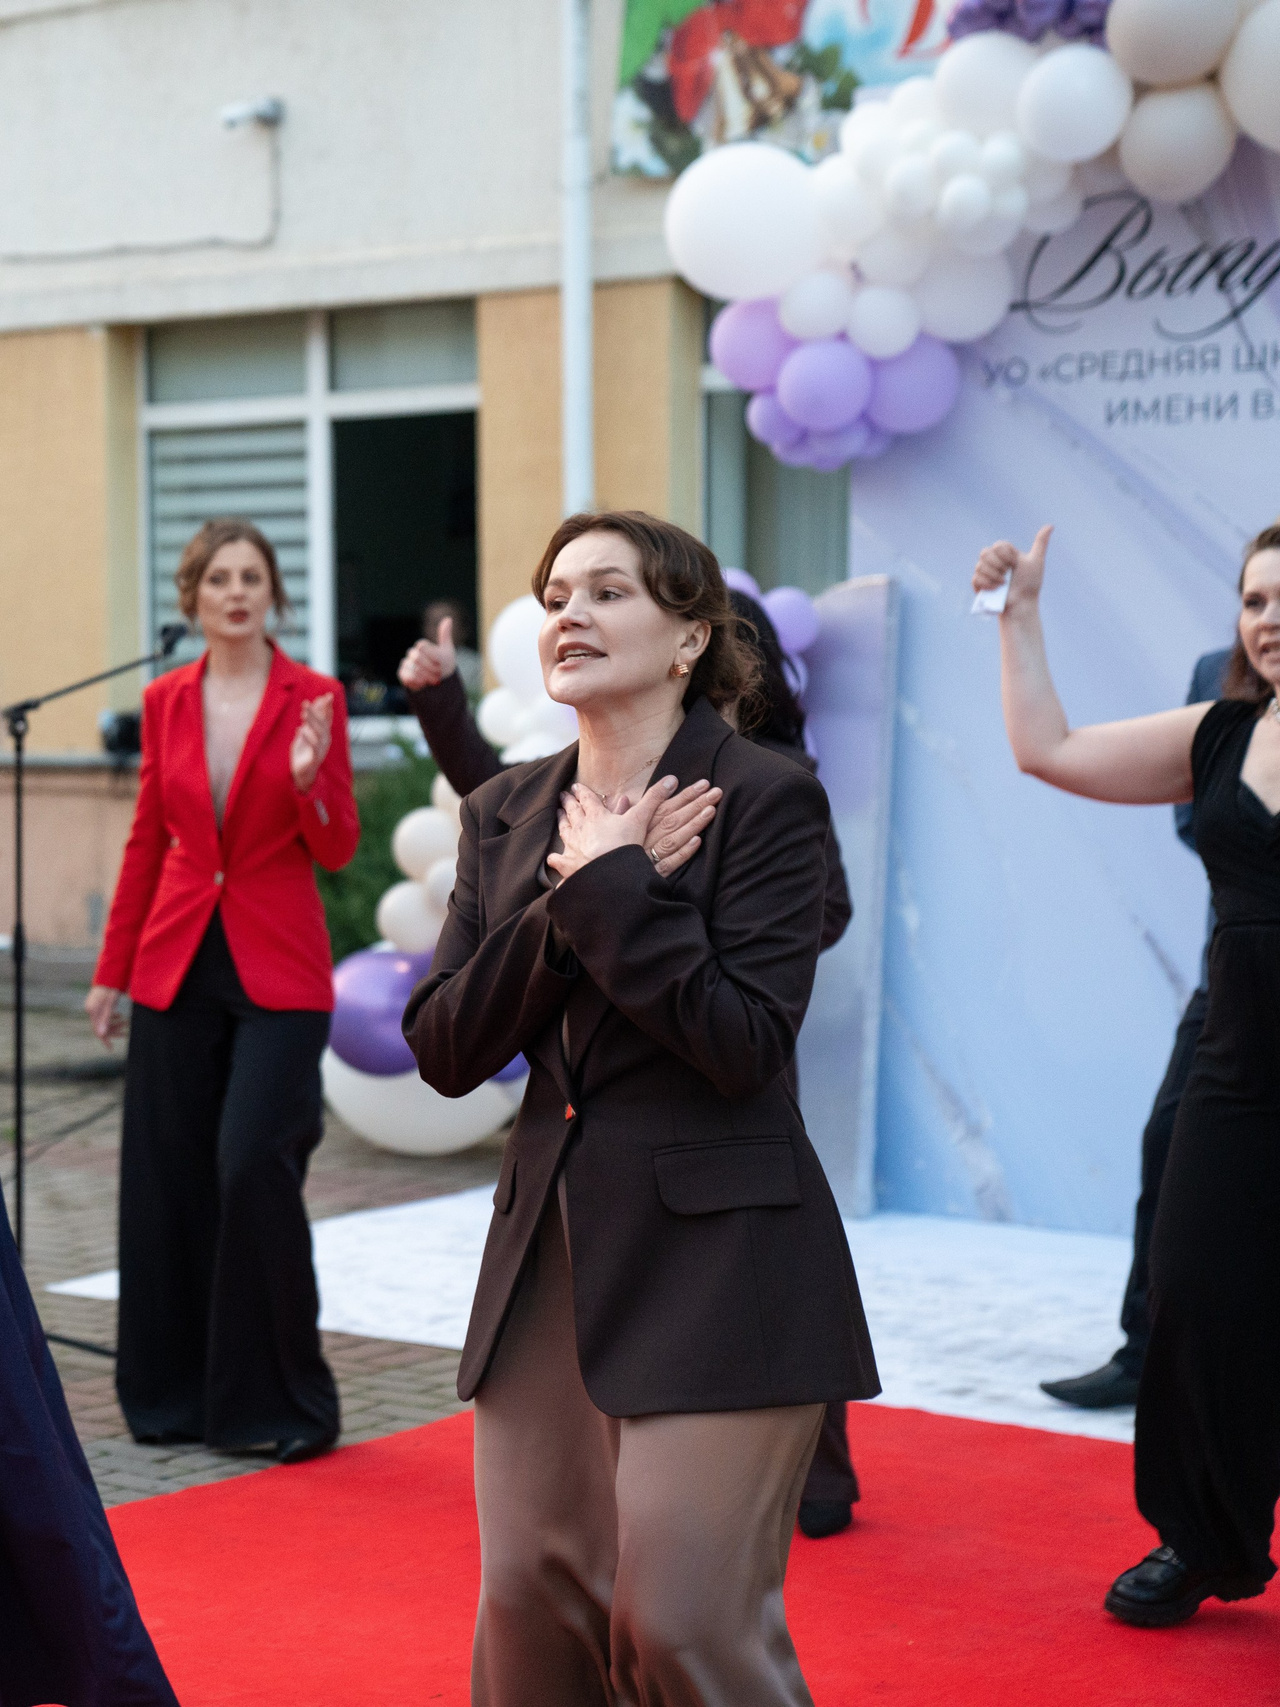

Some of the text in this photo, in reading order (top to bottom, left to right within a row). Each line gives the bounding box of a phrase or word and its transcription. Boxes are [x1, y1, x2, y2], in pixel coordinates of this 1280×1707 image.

[983, 356, 1029, 387] УО
[1037, 344, 1221, 384] «СРЕДНЯЯ
[1104, 391, 1239, 426] ИМЕНИ
